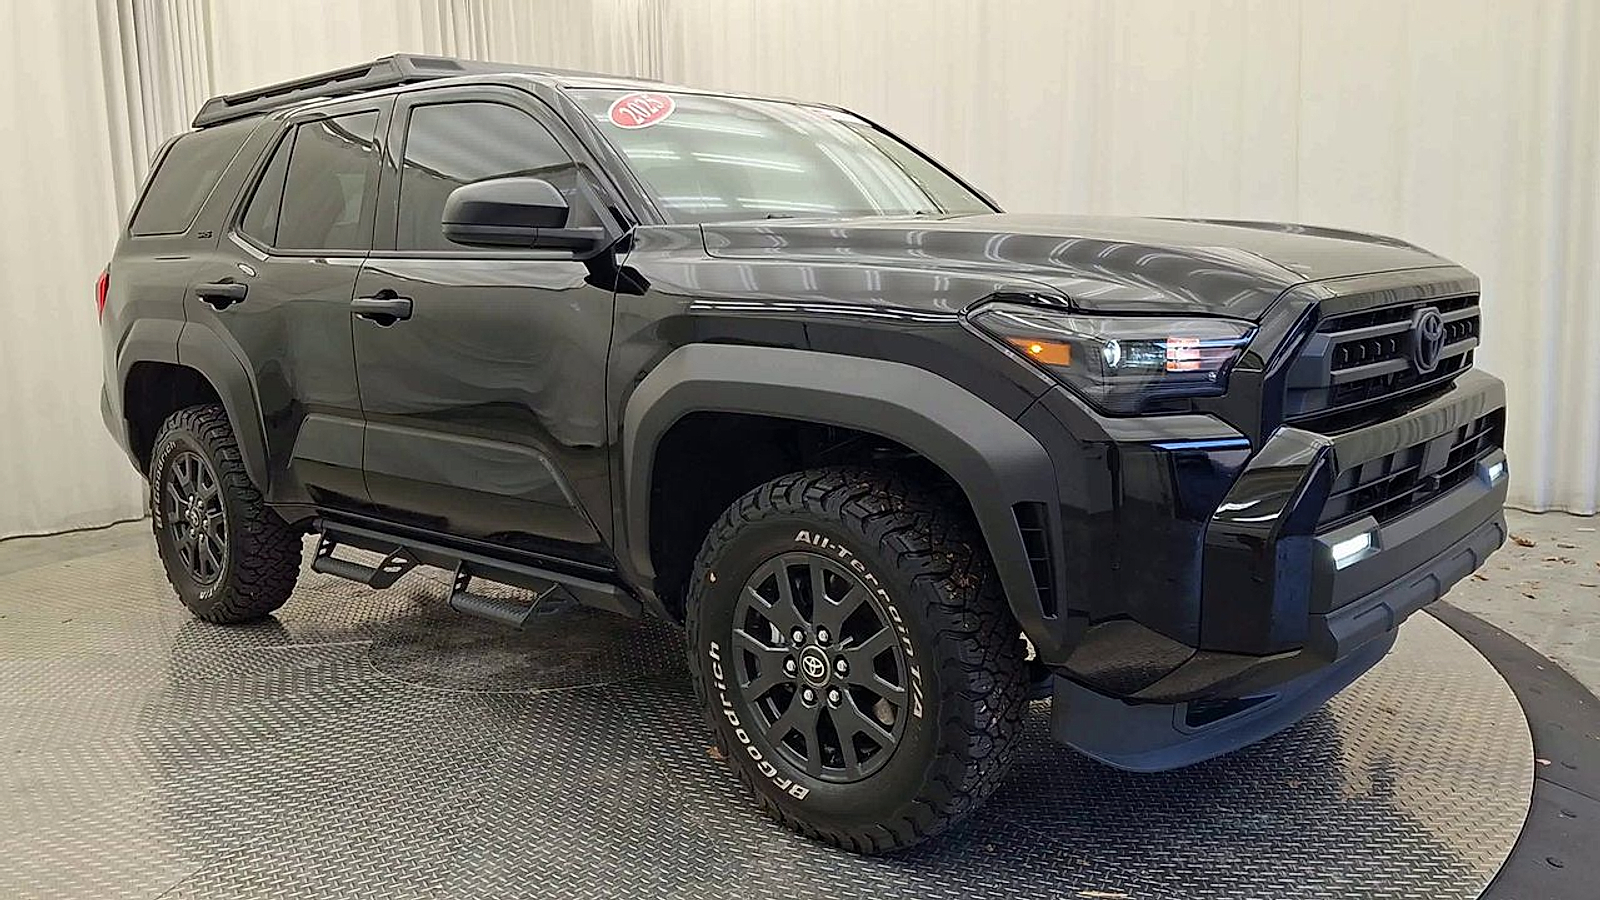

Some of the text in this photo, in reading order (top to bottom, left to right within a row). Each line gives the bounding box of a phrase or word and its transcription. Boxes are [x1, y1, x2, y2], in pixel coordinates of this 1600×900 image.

[619, 93, 664, 124] 2025
[794, 530, 924, 719] All-Terrain T/A
[708, 640, 810, 801] BFGoodrich
